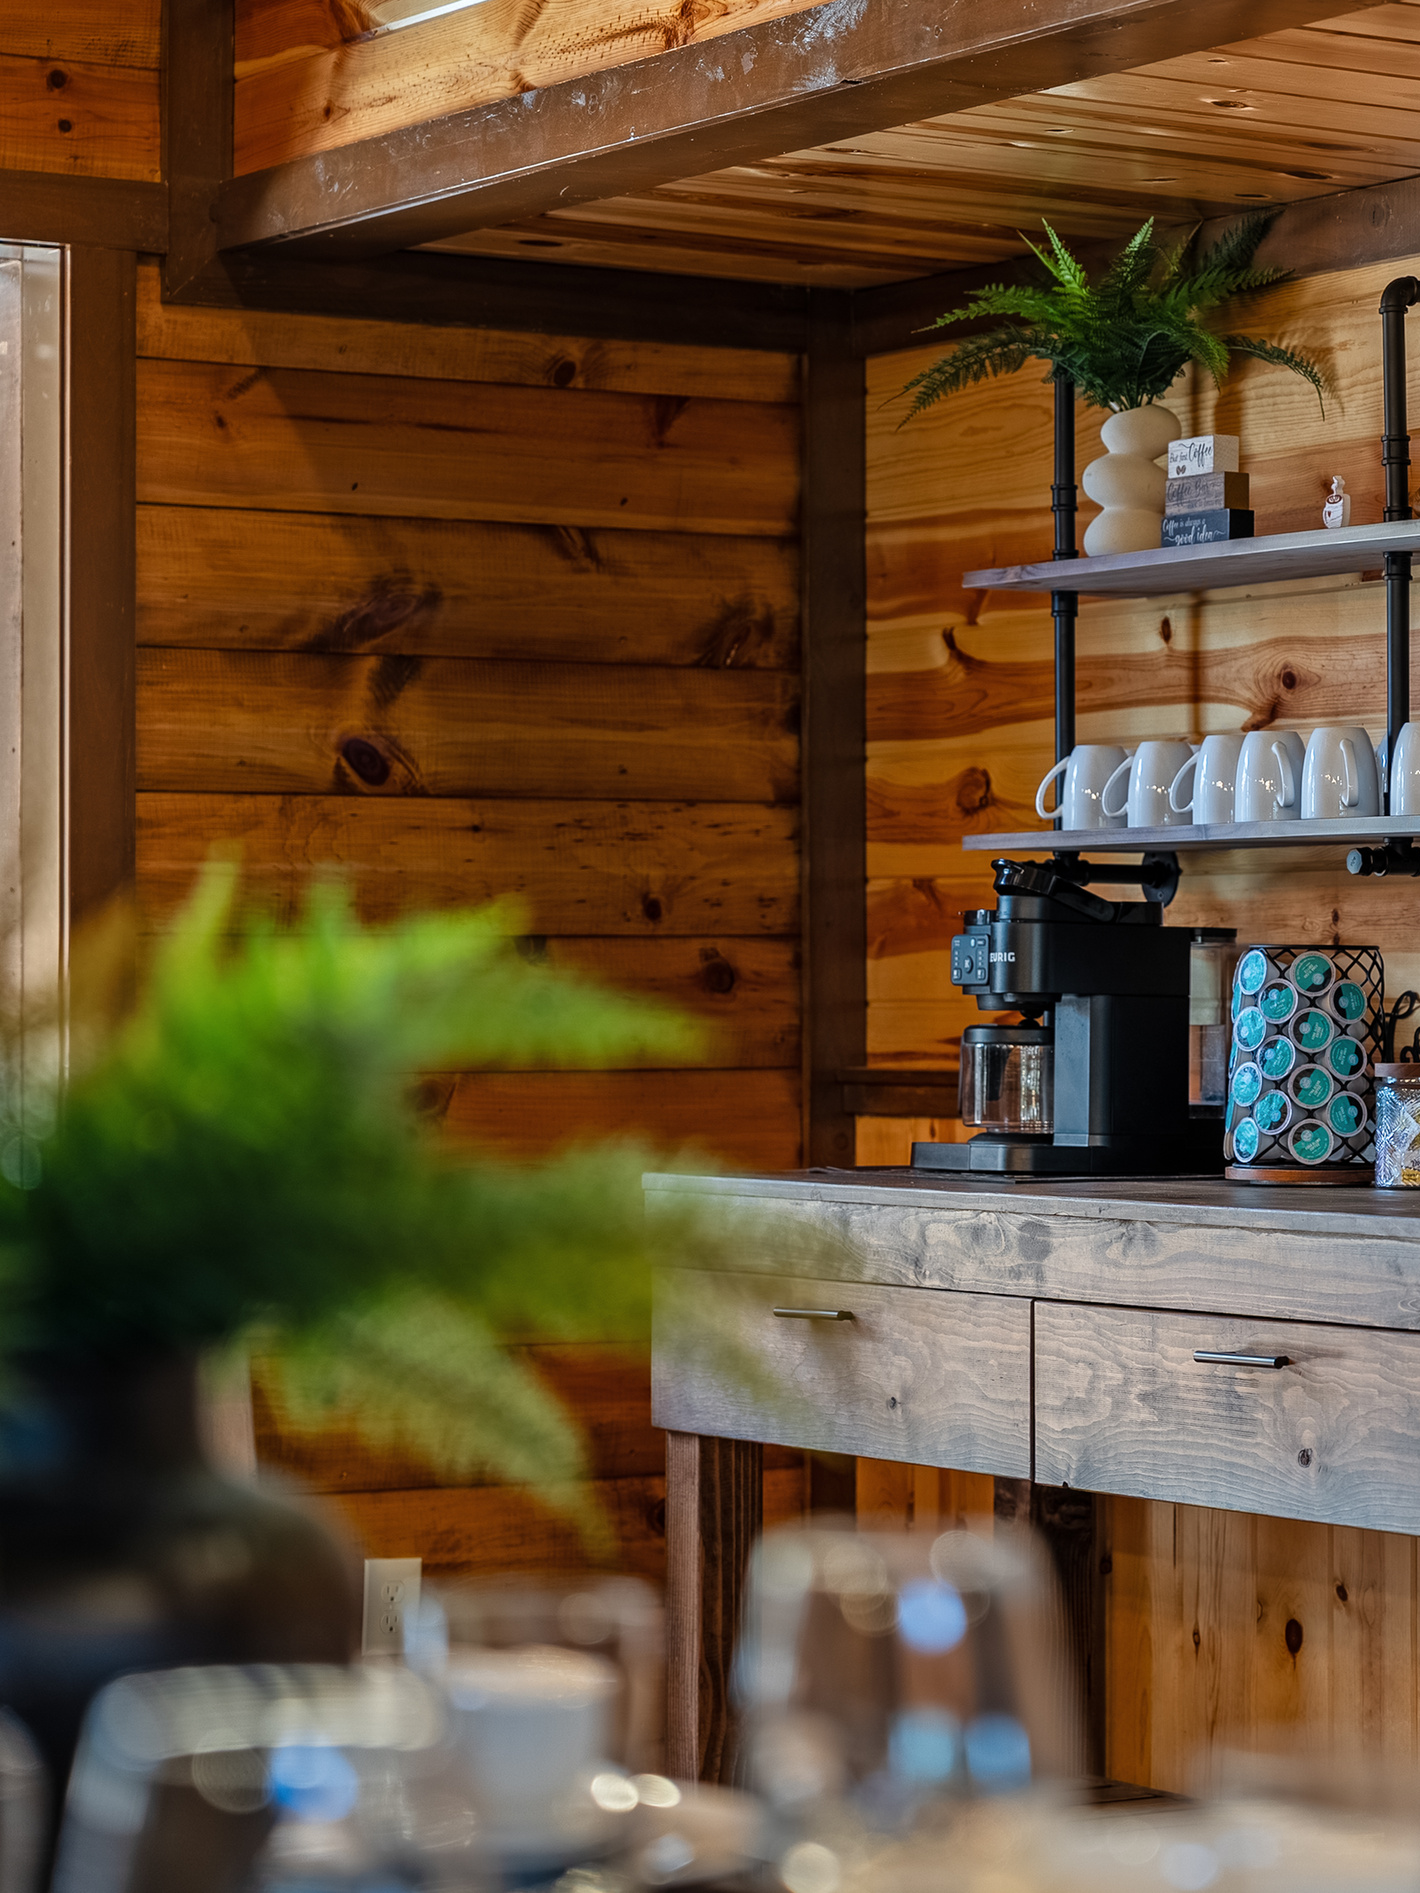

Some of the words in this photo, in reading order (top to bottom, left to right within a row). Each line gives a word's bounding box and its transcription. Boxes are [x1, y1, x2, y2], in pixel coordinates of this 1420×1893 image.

[1188, 442, 1212, 468] Coffee
[1166, 482, 1191, 507] Coffee
[1163, 518, 1179, 537] Coffee
[1174, 525, 1196, 546] good
[1196, 523, 1214, 542] idea
[989, 951, 1016, 963] EURIG
